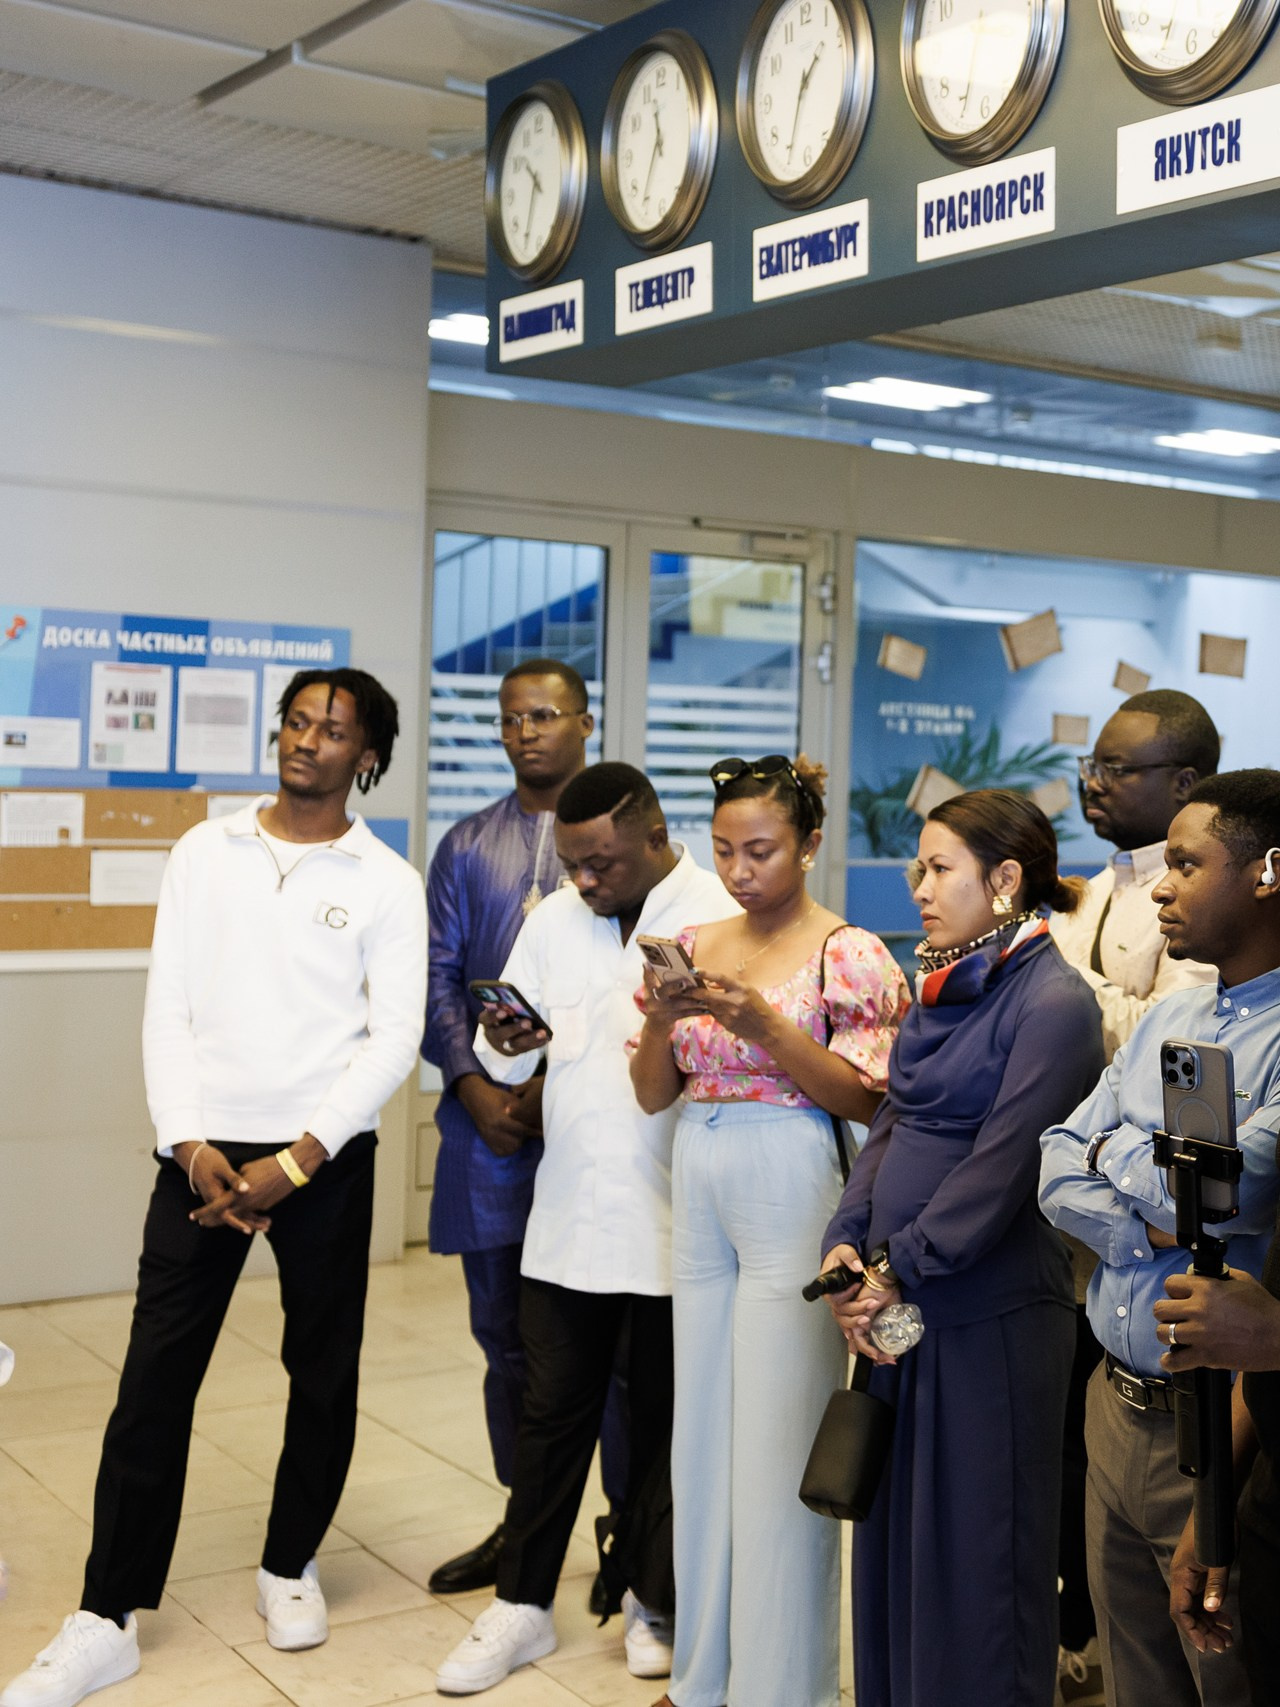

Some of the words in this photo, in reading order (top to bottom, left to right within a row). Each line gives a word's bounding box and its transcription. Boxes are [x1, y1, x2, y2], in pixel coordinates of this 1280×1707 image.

[800, 2, 812, 26] 12
[784, 21, 793, 44] 11
[1186, 28, 1198, 55] 6
[770, 52, 782, 77] 10
[940, 76, 949, 99] 8
[764, 93, 772, 115] 9
[980, 95, 990, 119] 6
[771, 126, 779, 146] 8
[803, 145, 812, 167] 6
[1154, 118, 1241, 182] ЯКУТСК
[924, 171, 1045, 238] КРАСНОЯРСК
[42, 625, 111, 649] ДОСКА
[117, 630, 207, 656] ЧАСТНЫХ
[211, 635, 333, 662] ОБЪЯВЛЕНИЙ
[1122, 1382, 1133, 1397] G
